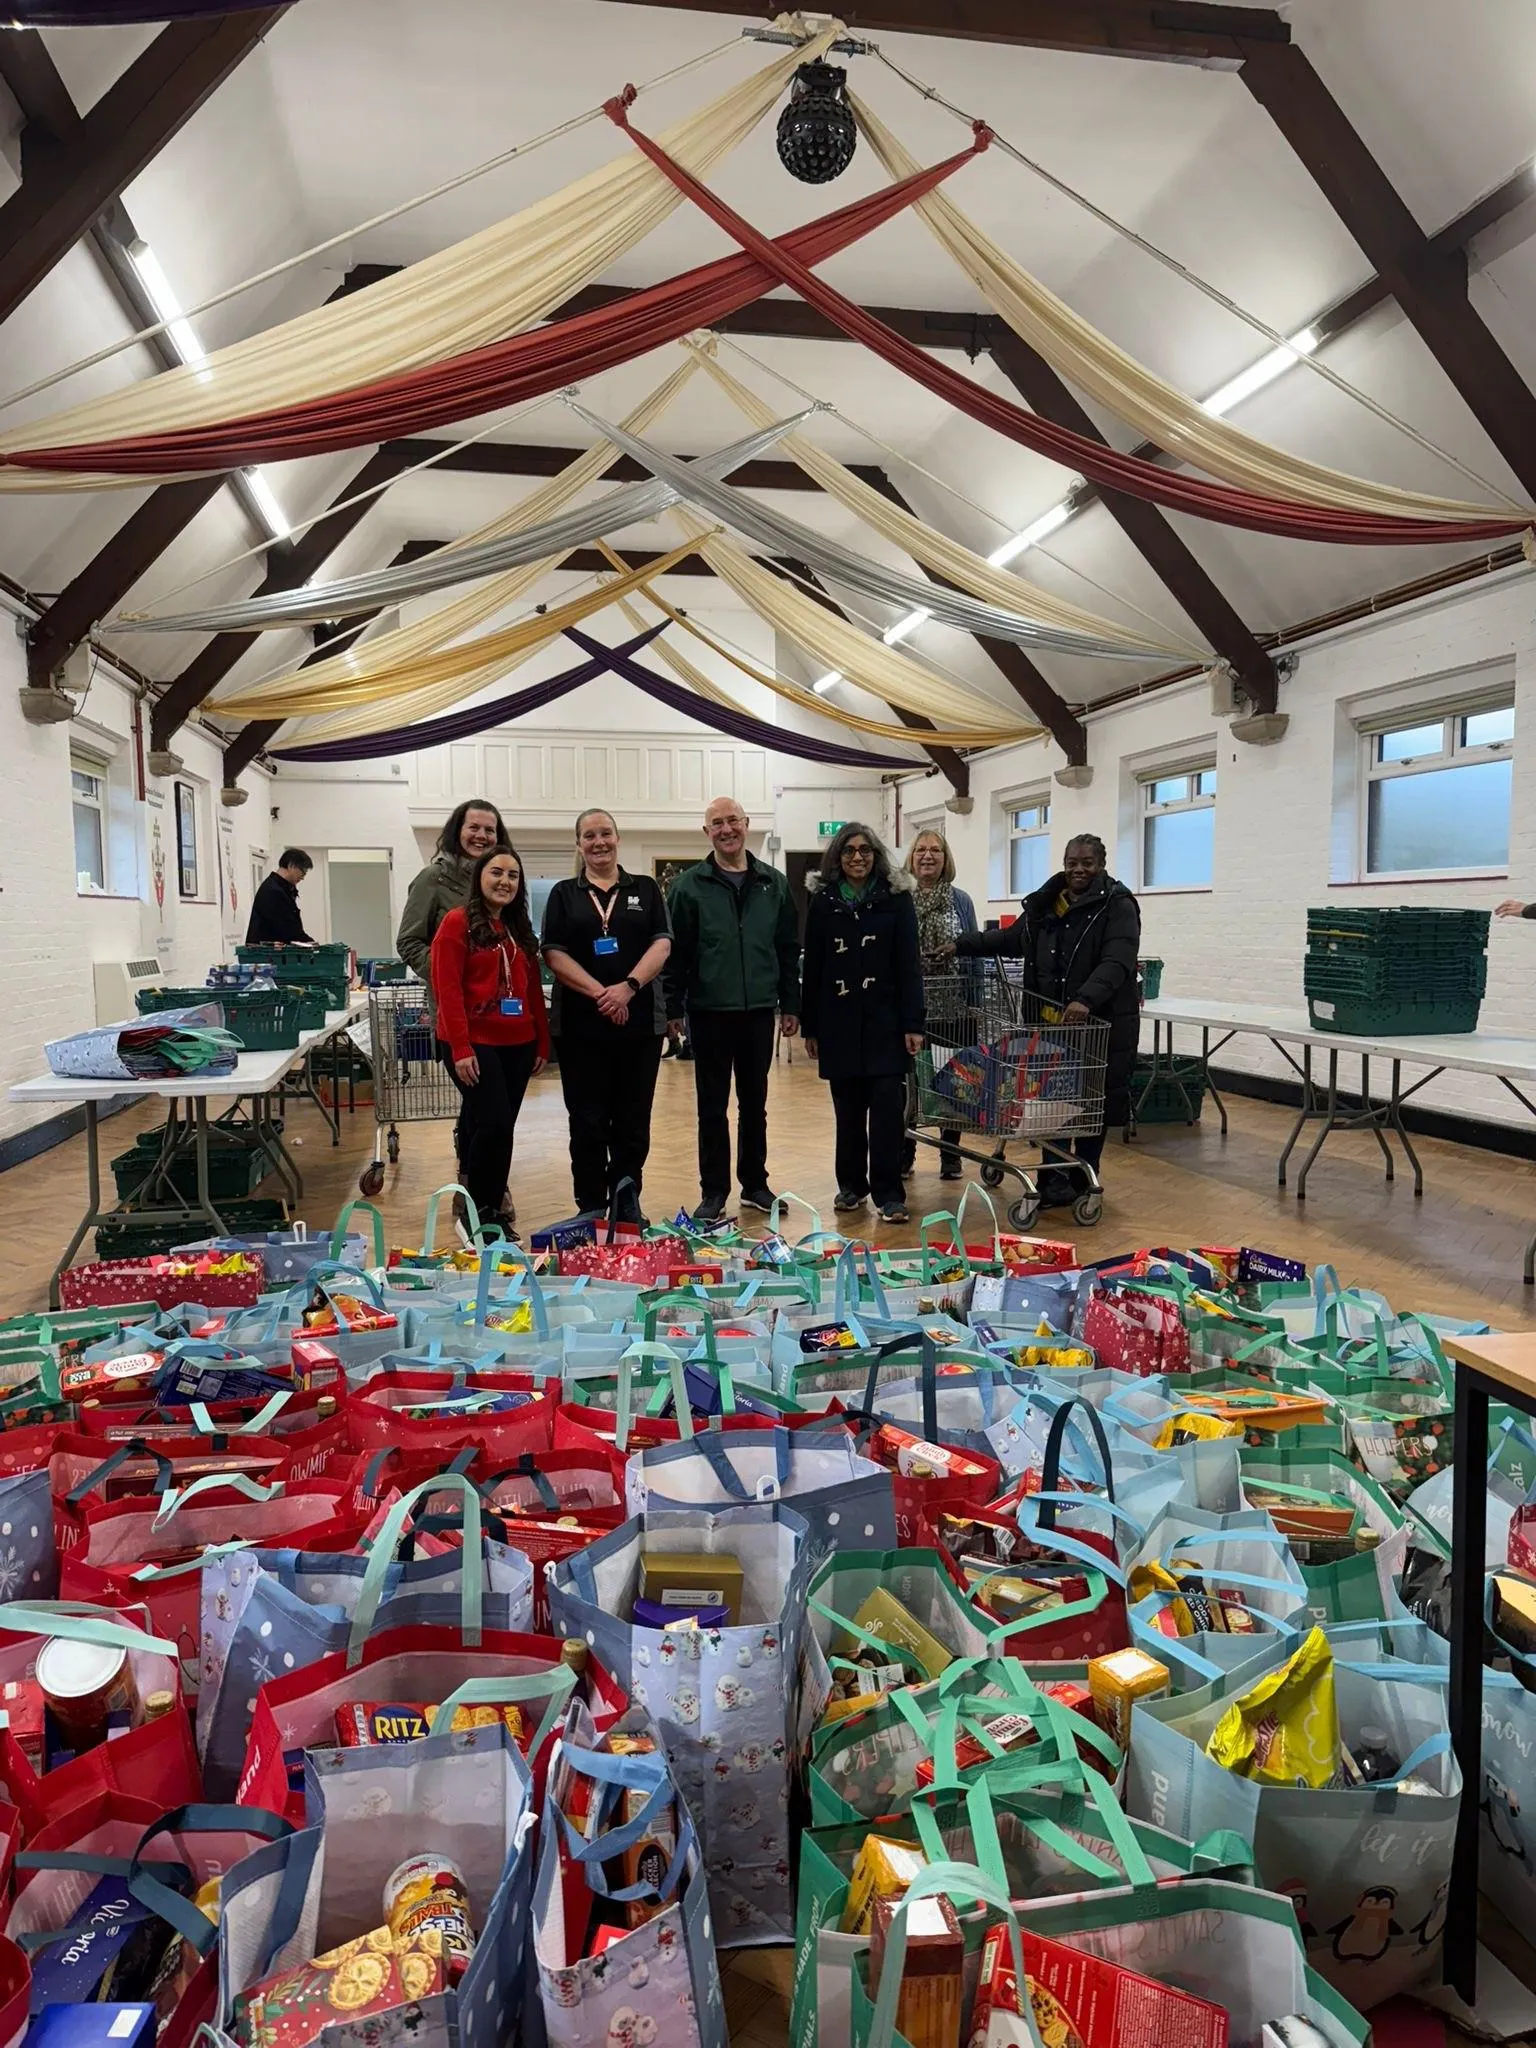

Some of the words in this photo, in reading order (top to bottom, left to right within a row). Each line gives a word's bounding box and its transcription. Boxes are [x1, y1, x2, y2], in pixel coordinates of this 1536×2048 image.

[1249, 1262, 1268, 1275] DAIRY
[1268, 1268, 1284, 1280] MILK
[734, 1394, 754, 1408] toria
[374, 1716, 427, 1740] RITZ
[399, 1901, 465, 1934] TBALLS
[406, 1916, 468, 1938] HEESE
[61, 1899, 130, 1965] Vicoria
